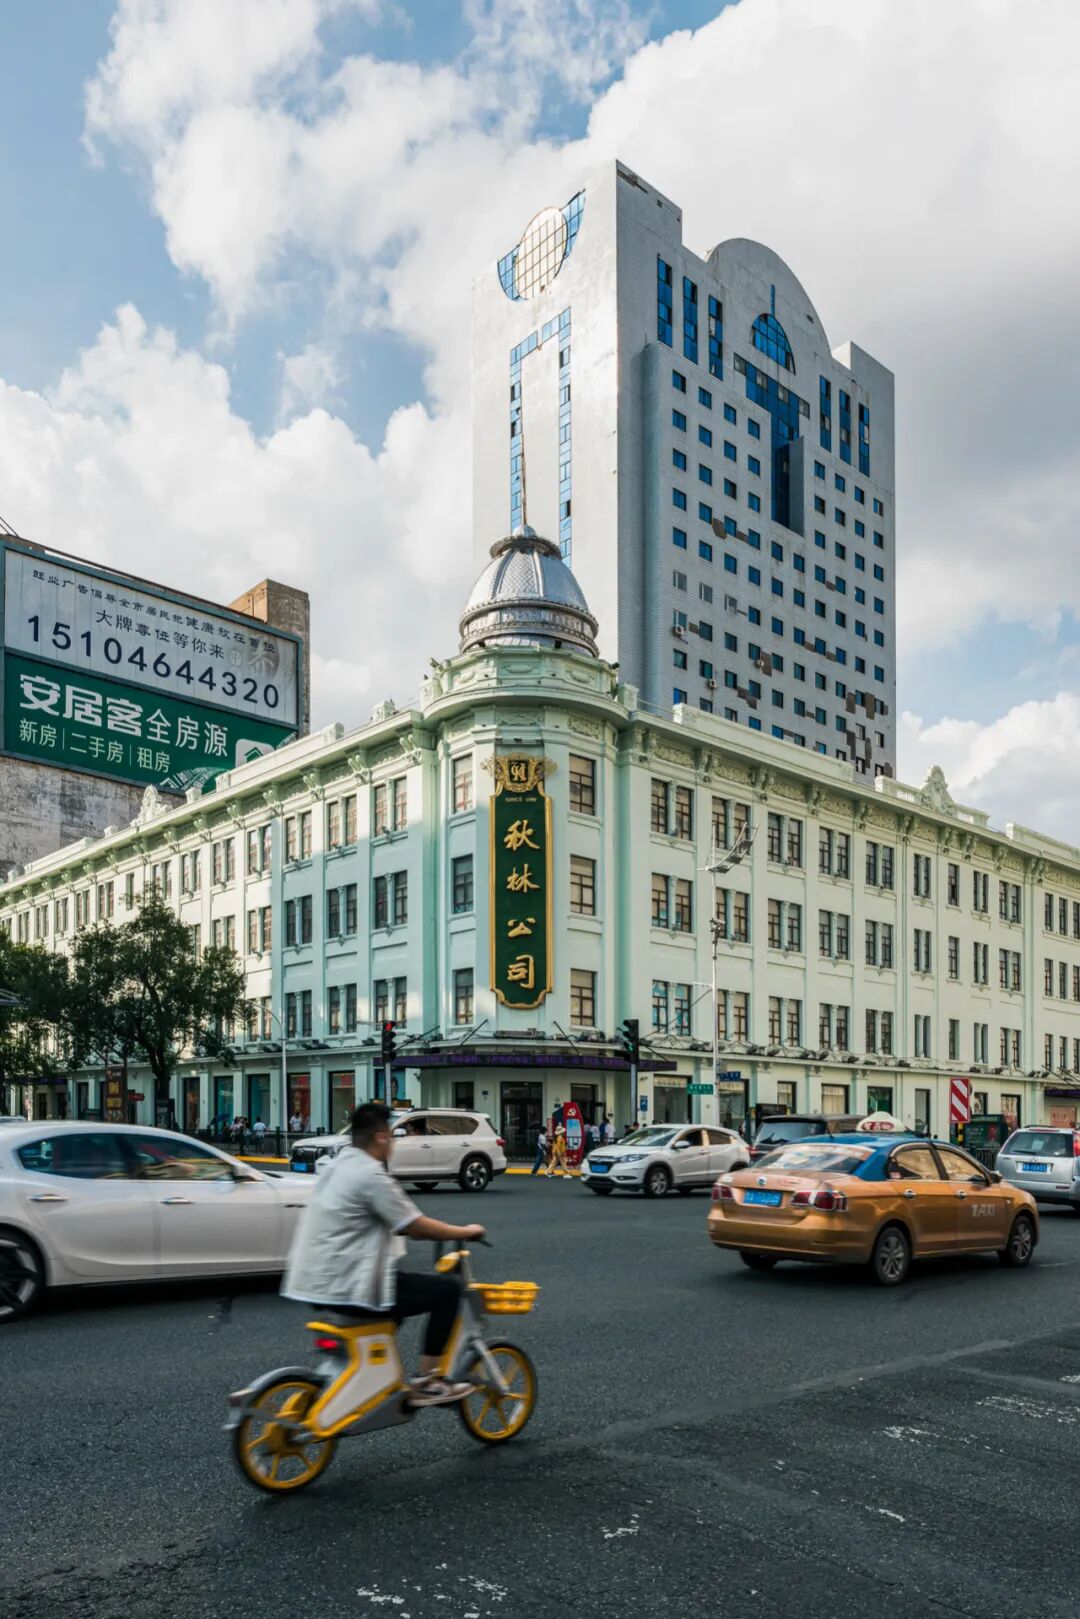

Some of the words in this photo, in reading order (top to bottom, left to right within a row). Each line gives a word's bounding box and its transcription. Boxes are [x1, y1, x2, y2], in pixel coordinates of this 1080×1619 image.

[27, 614, 279, 708] 15104644320
[503, 818, 541, 990] 秋林公司
[971, 1203, 996, 1217] TAXI
